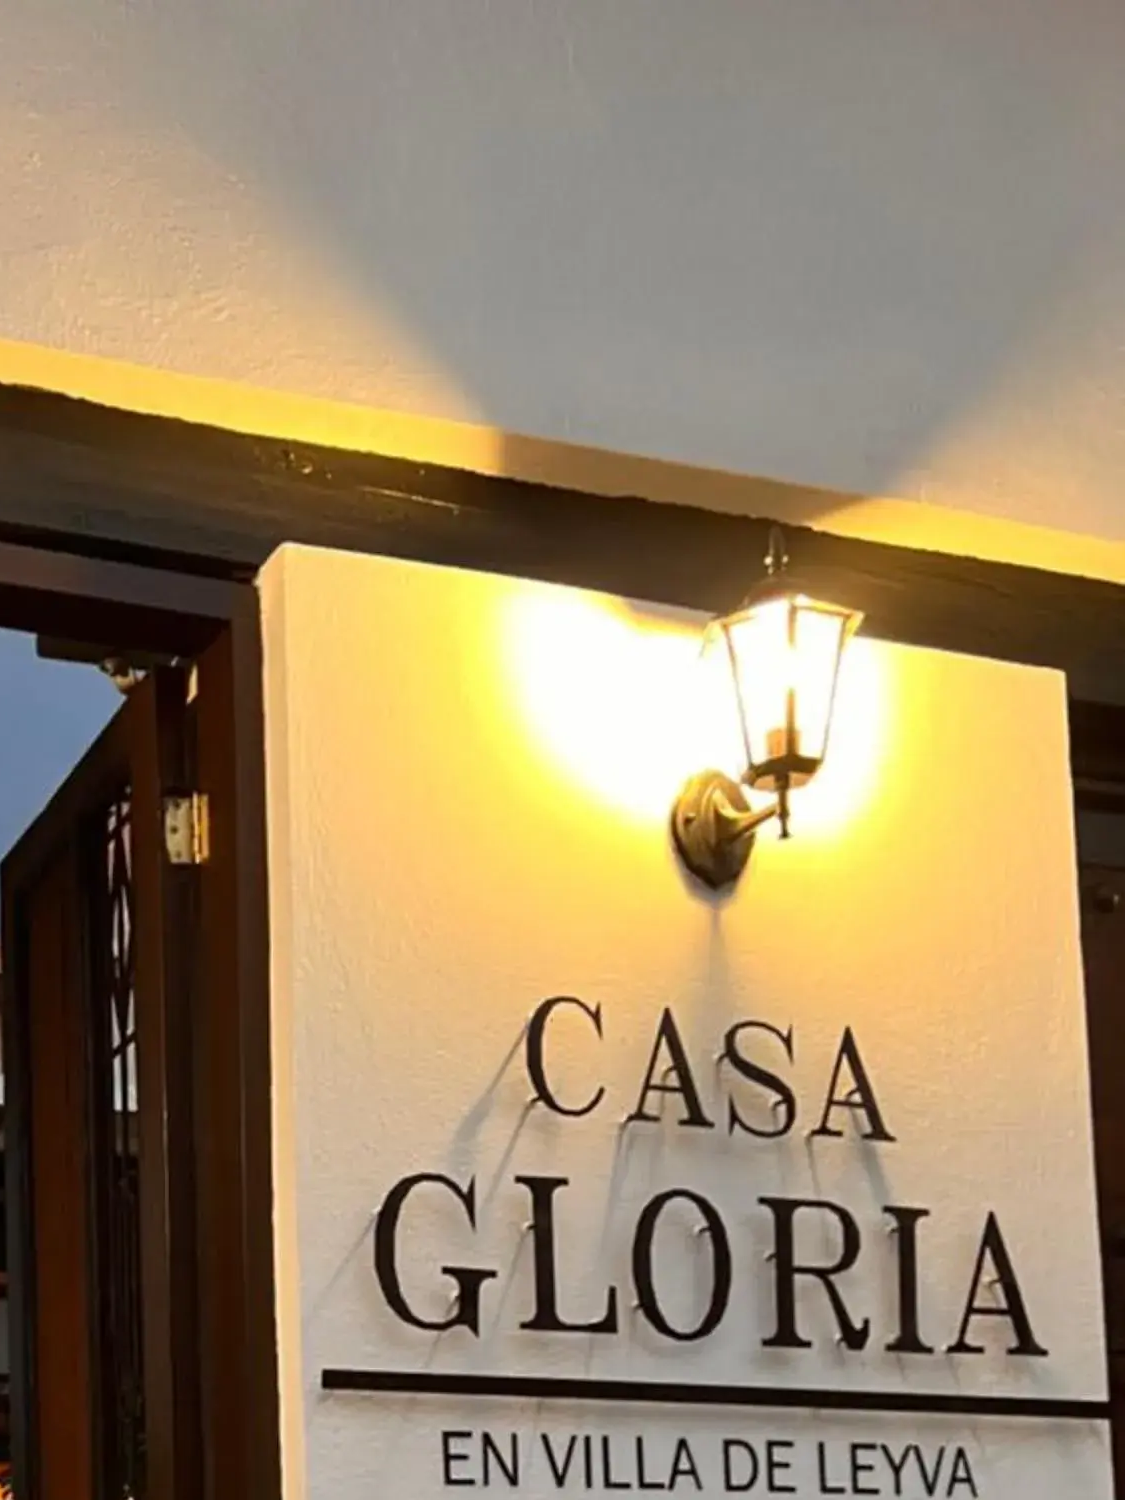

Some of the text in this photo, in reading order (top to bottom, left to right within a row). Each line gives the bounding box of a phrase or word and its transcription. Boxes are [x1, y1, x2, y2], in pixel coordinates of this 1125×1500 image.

[526, 996, 897, 1142] CASA
[373, 1172, 1050, 1357] GLORIA
[442, 1431, 979, 1499] EN VILLA DE LEYVA
